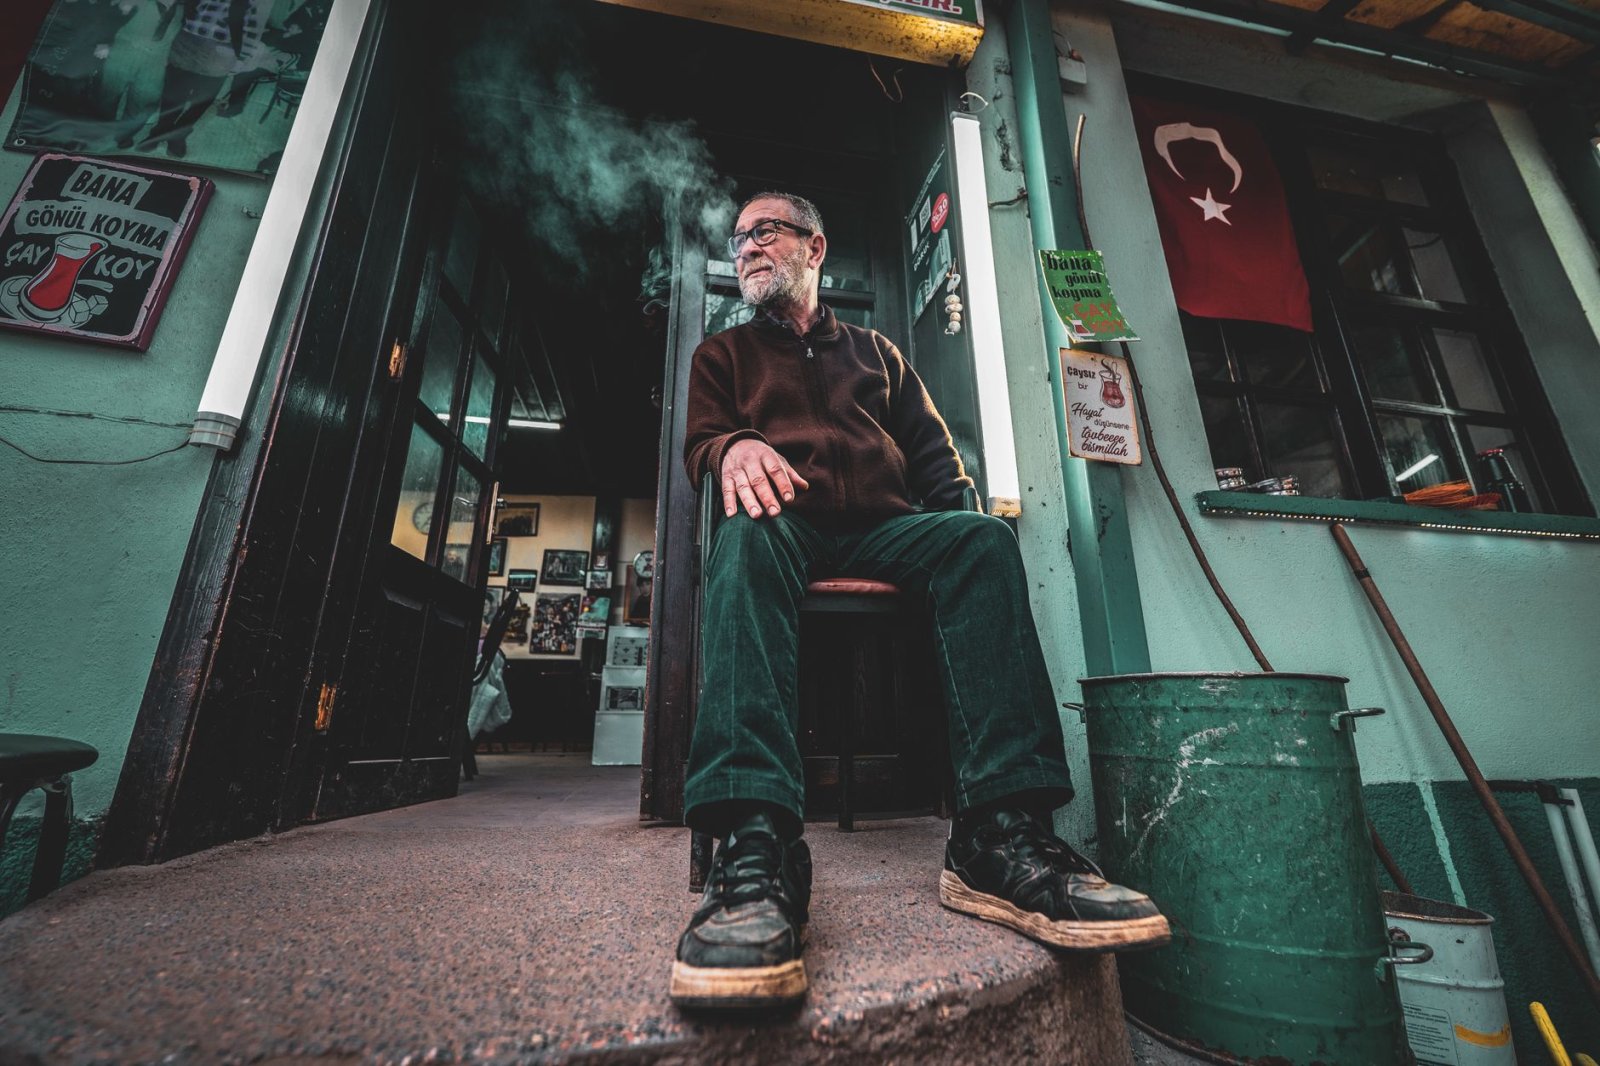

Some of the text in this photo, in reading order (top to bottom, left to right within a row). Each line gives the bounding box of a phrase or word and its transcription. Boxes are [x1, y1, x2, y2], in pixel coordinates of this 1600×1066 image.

[70, 170, 140, 206] BANA
[26, 205, 169, 251] GÖNÜL KOYMA
[4, 241, 154, 280] ÇAY KOY
[1046, 253, 1092, 270] bana
[1065, 272, 1102, 287] gönül
[1051, 285, 1102, 301] koyma
[1077, 381, 1089, 390] bir
[1071, 402, 1105, 420] Hayat
[1094, 419, 1130, 431] düşünsene
[1081, 438, 1129, 457] bismillah
